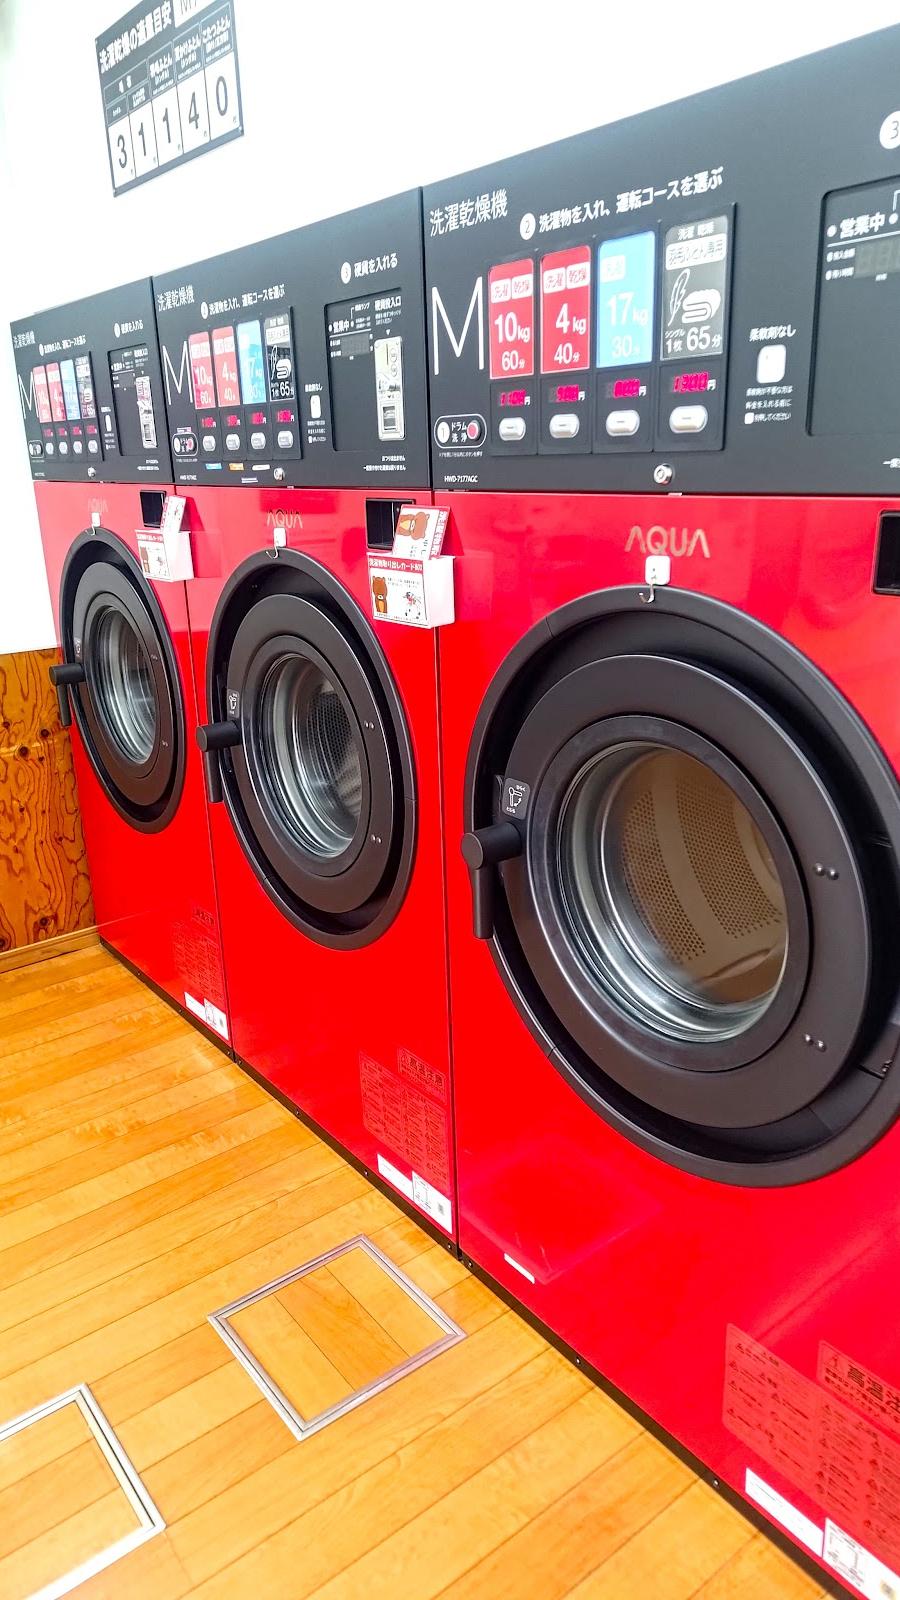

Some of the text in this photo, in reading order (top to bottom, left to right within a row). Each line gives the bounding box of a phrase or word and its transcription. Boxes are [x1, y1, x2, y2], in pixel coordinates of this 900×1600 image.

[117, 134, 128, 169] 3
[138, 121, 147, 157] 1
[162, 107, 171, 144] 1
[188, 91, 200, 130] 4
[215, 75, 228, 117] 0
[429, 189, 508, 237] 洗濯乾燥機
[538, 166, 724, 233] 洗濯物を入れ、運転コースを選ぶ
[839, 212, 886, 239] 営業中
[354, 252, 398, 278] 硬貨を入れる
[157, 285, 195, 312] 洗濯乾燥機
[431, 275, 485, 376] M
[494, 311, 531, 344] 10kg
[686, 325, 723, 352] 65分
[162, 340, 193, 406] M
[17, 371, 40, 420] M
[451, 422, 467, 432] ドラム
[265, 509, 304, 529] AQUA
[624, 524, 711, 559] AQUA
